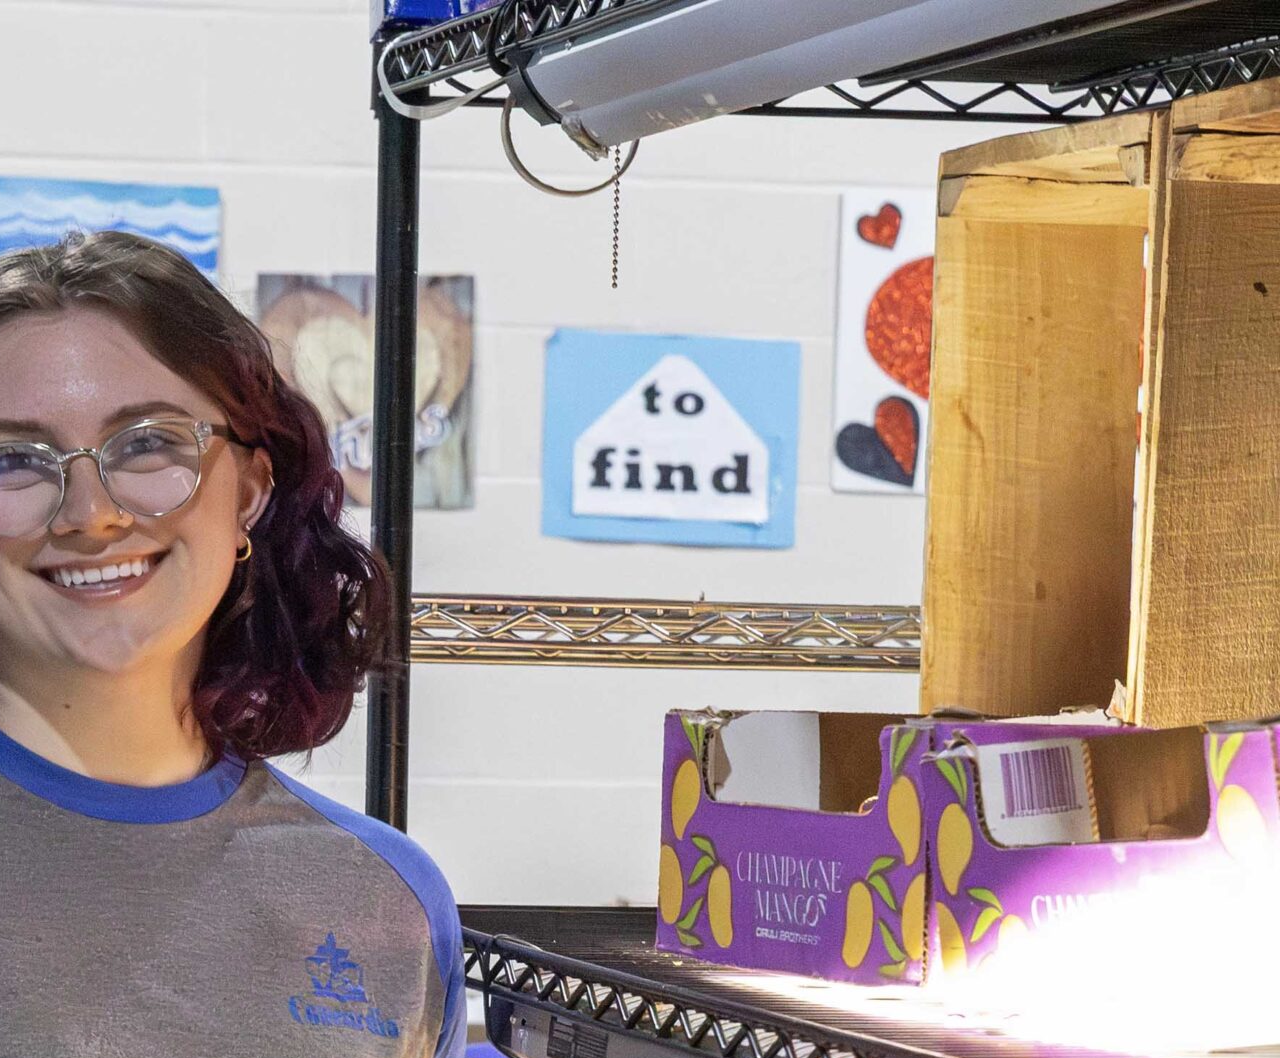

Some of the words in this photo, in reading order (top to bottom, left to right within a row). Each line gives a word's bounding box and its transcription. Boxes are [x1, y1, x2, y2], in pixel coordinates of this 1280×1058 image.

[643, 381, 705, 415] to
[590, 446, 751, 494] find
[736, 851, 842, 893] CHAMPAGNE
